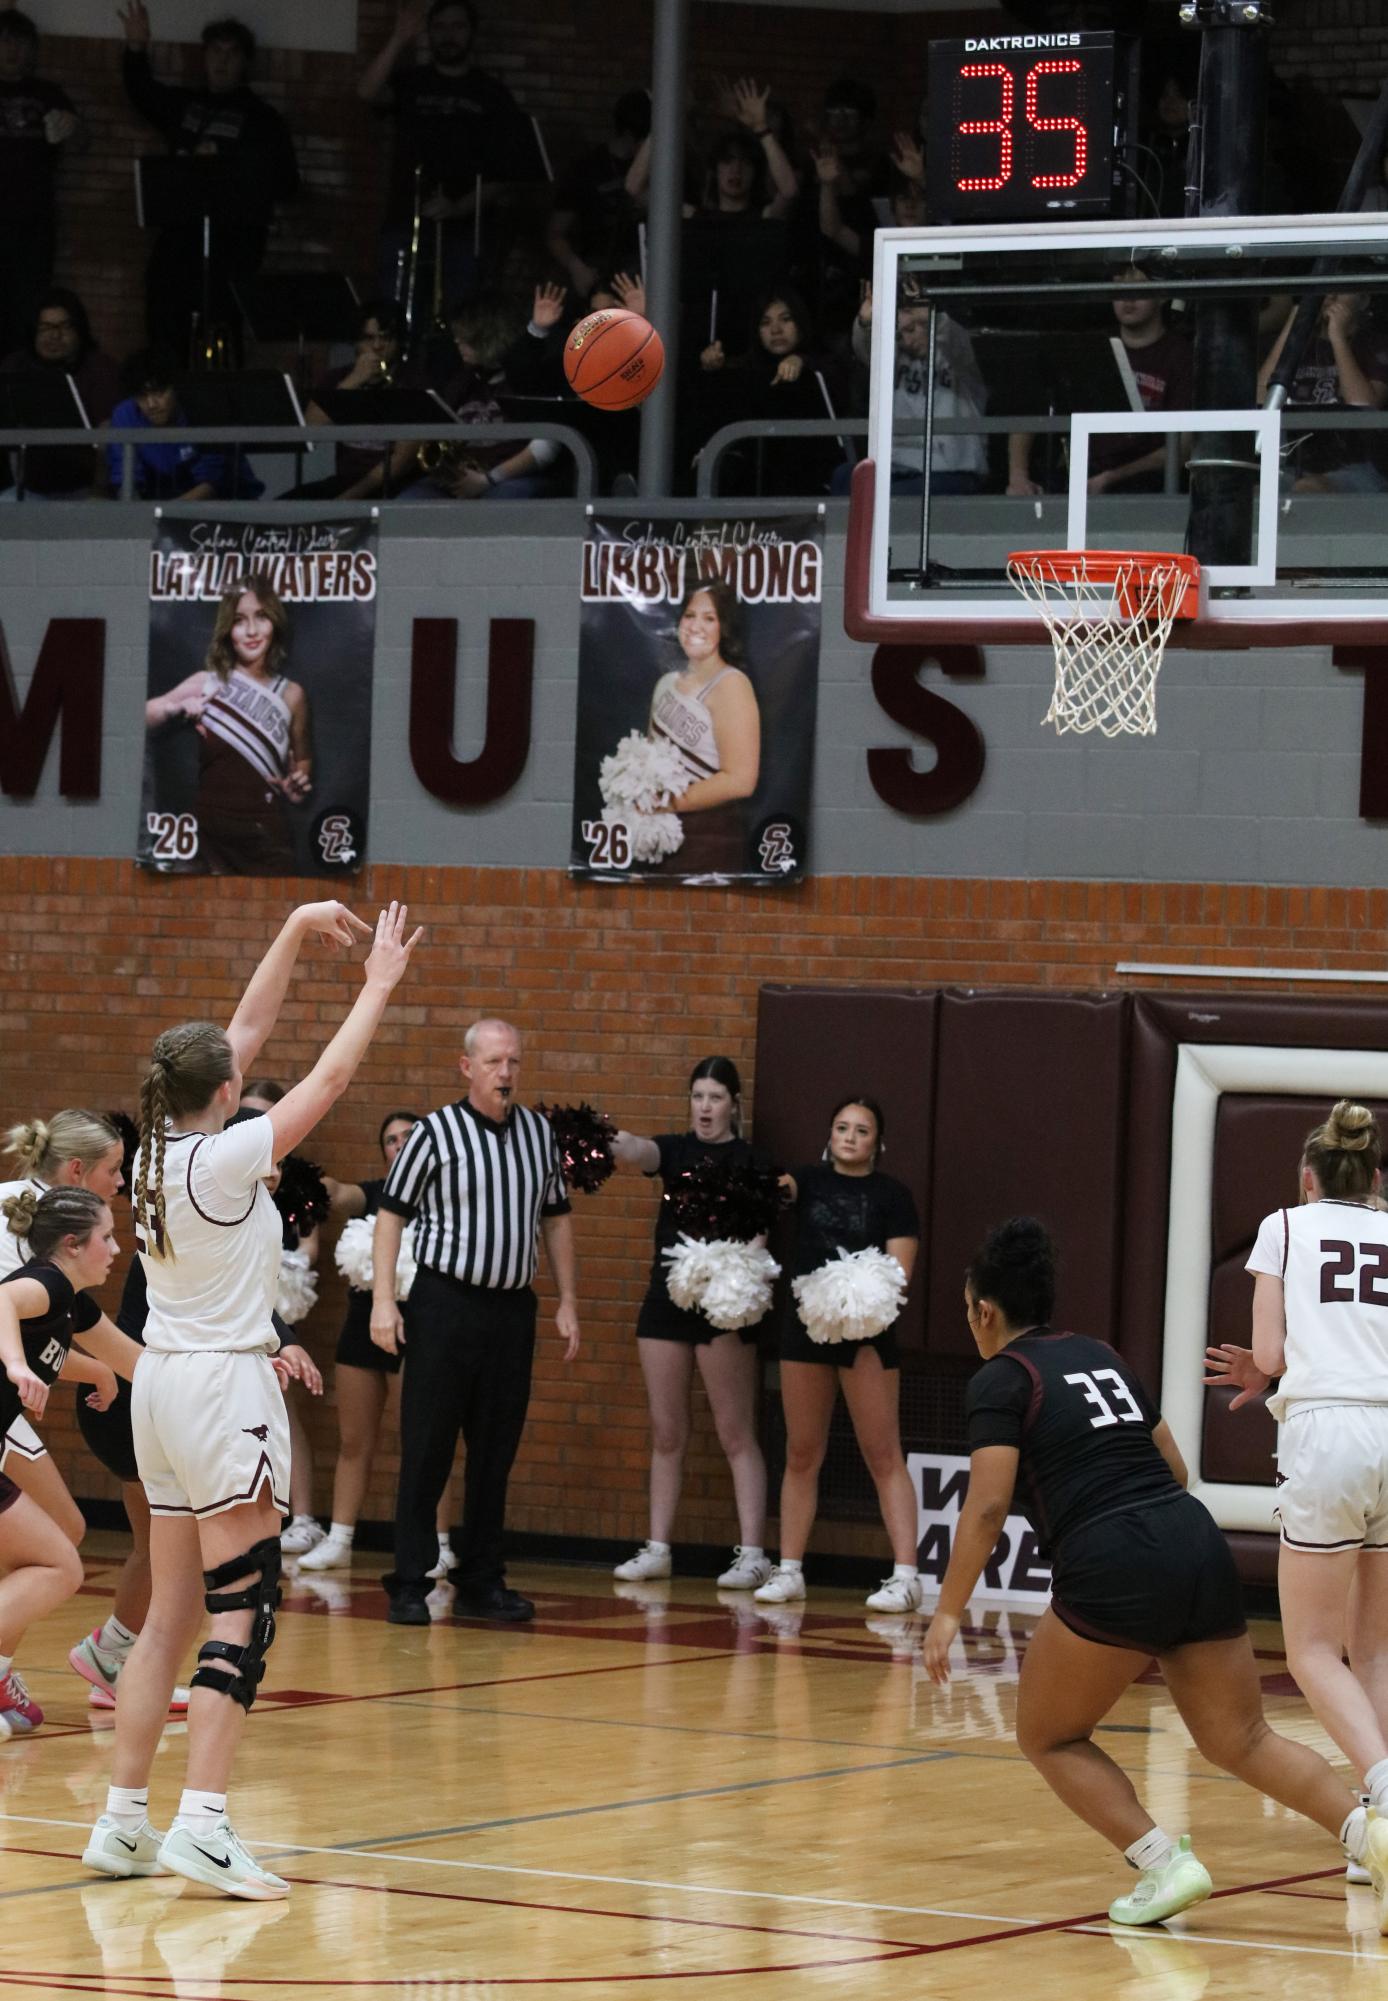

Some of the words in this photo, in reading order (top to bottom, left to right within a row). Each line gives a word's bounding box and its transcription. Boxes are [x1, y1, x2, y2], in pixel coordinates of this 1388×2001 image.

[964, 33, 1081, 51] DAKTRONICS
[957, 60, 1087, 191] 35
[150, 551, 244, 600] LAYLA
[250, 550, 377, 601] WATERS
[581, 541, 685, 604] LIBBY
[147, 812, 198, 859] '26
[582, 820, 632, 869] '26
[1320, 1240, 1388, 1307] 22
[39, 1337, 67, 1371] BU
[1063, 1369, 1143, 1428] 33
